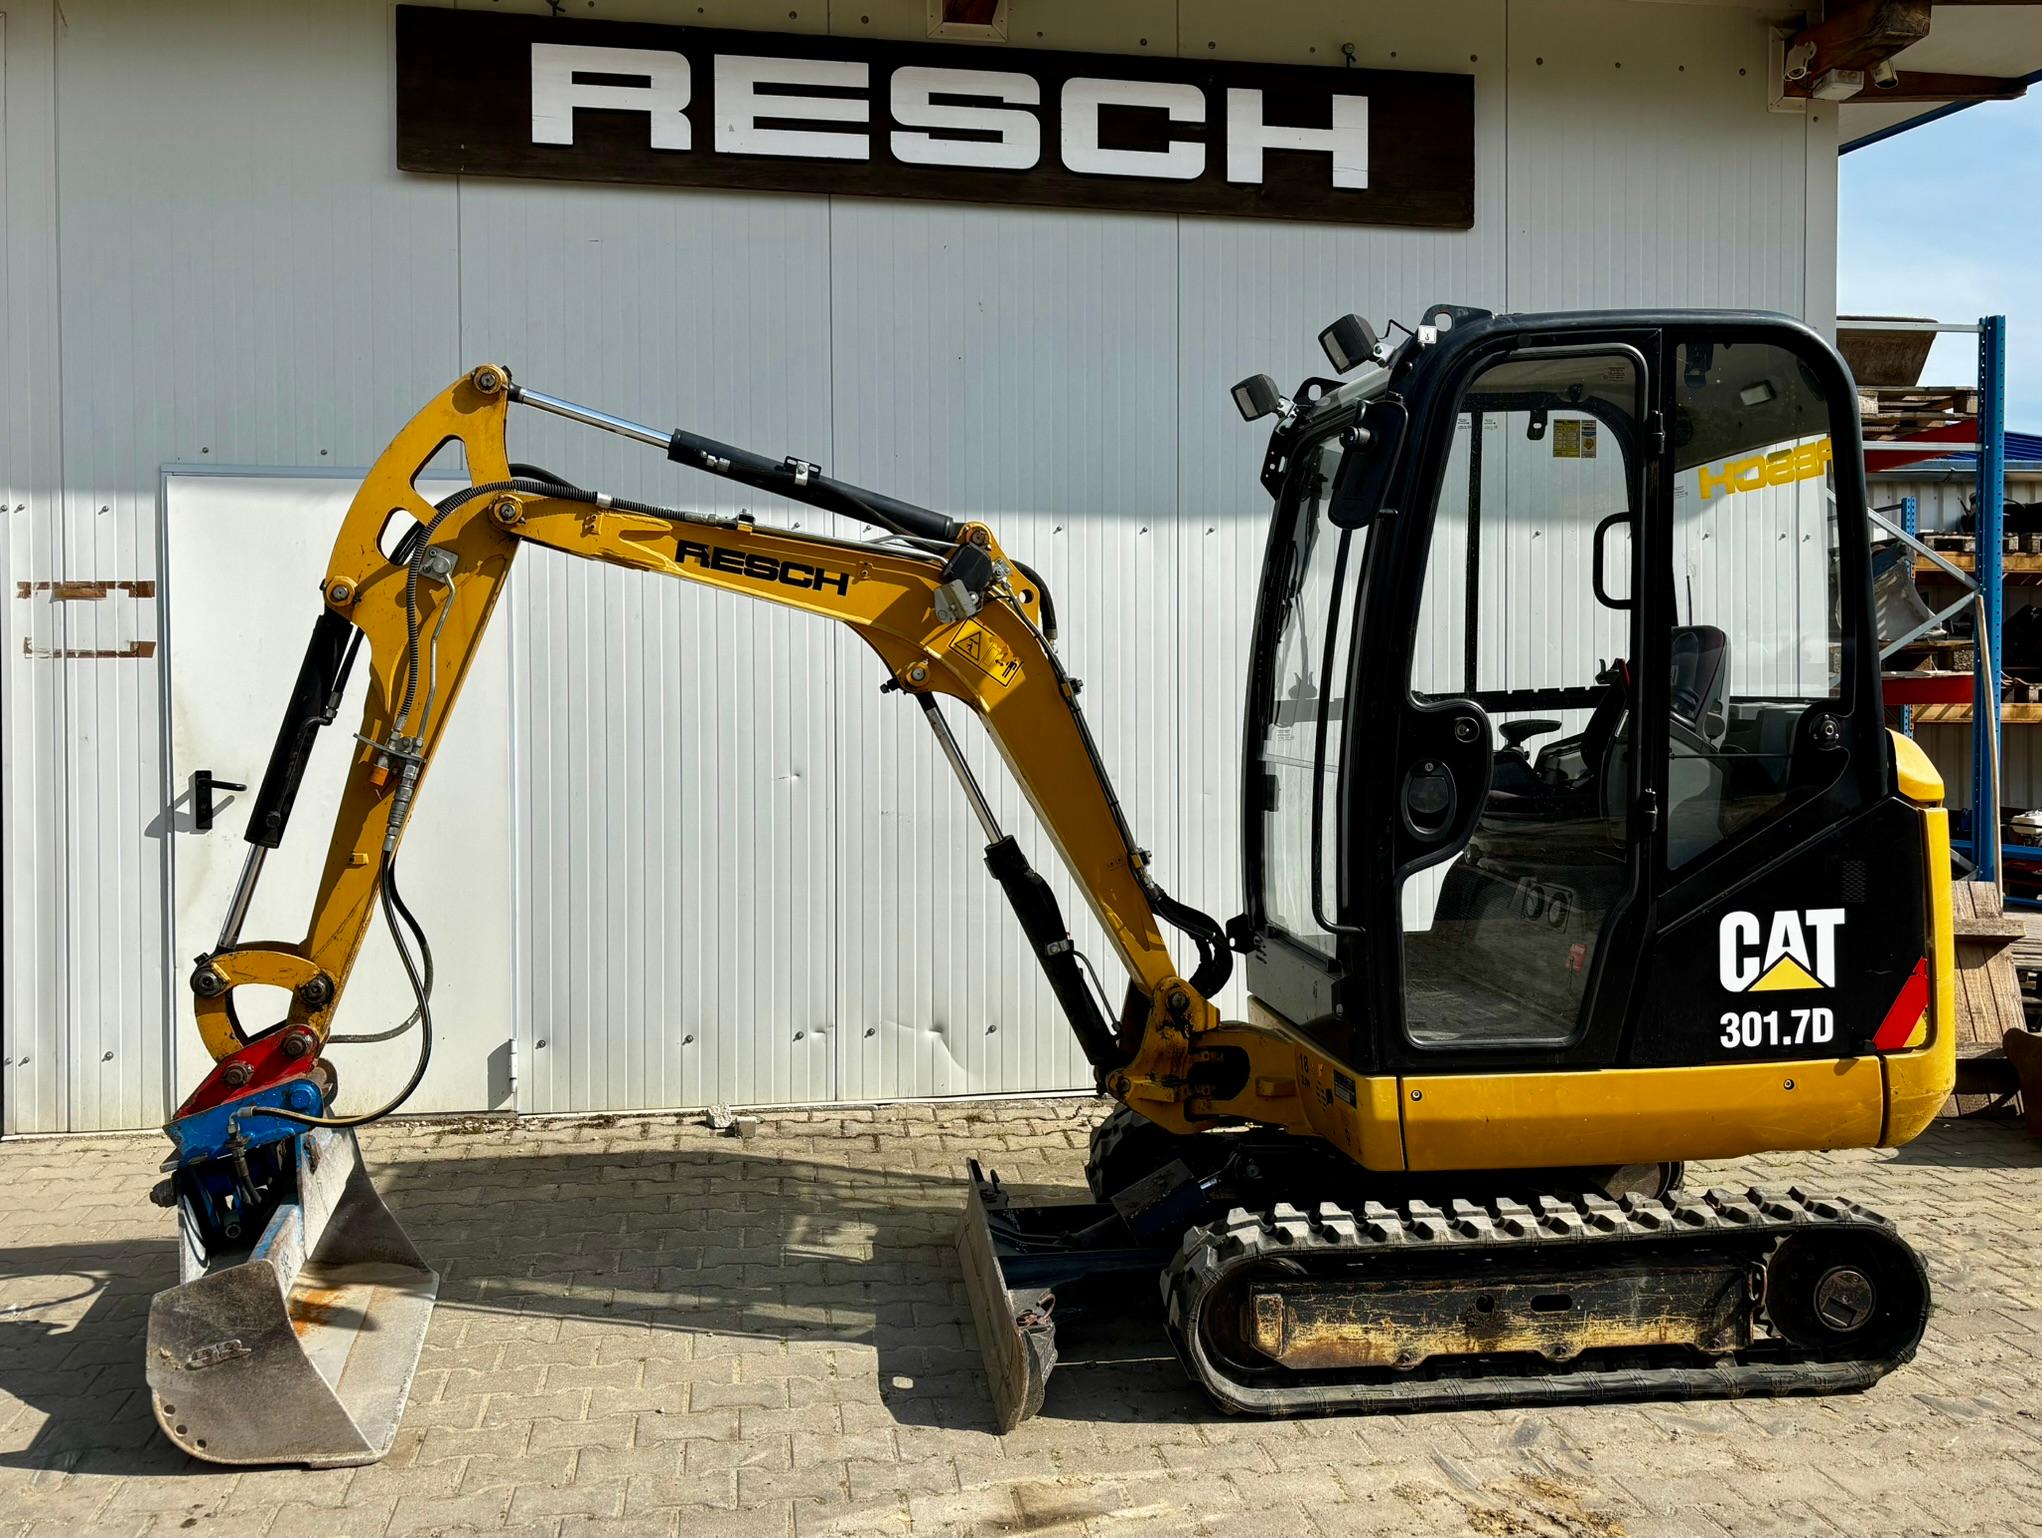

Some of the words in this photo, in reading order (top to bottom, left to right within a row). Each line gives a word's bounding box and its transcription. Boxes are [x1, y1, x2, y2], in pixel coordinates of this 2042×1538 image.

[530, 42, 1369, 190] RESCH
[675, 539, 849, 597] RESCH
[1719, 908, 1846, 993] CAT
[1720, 1007, 1834, 1048] 301.7D
